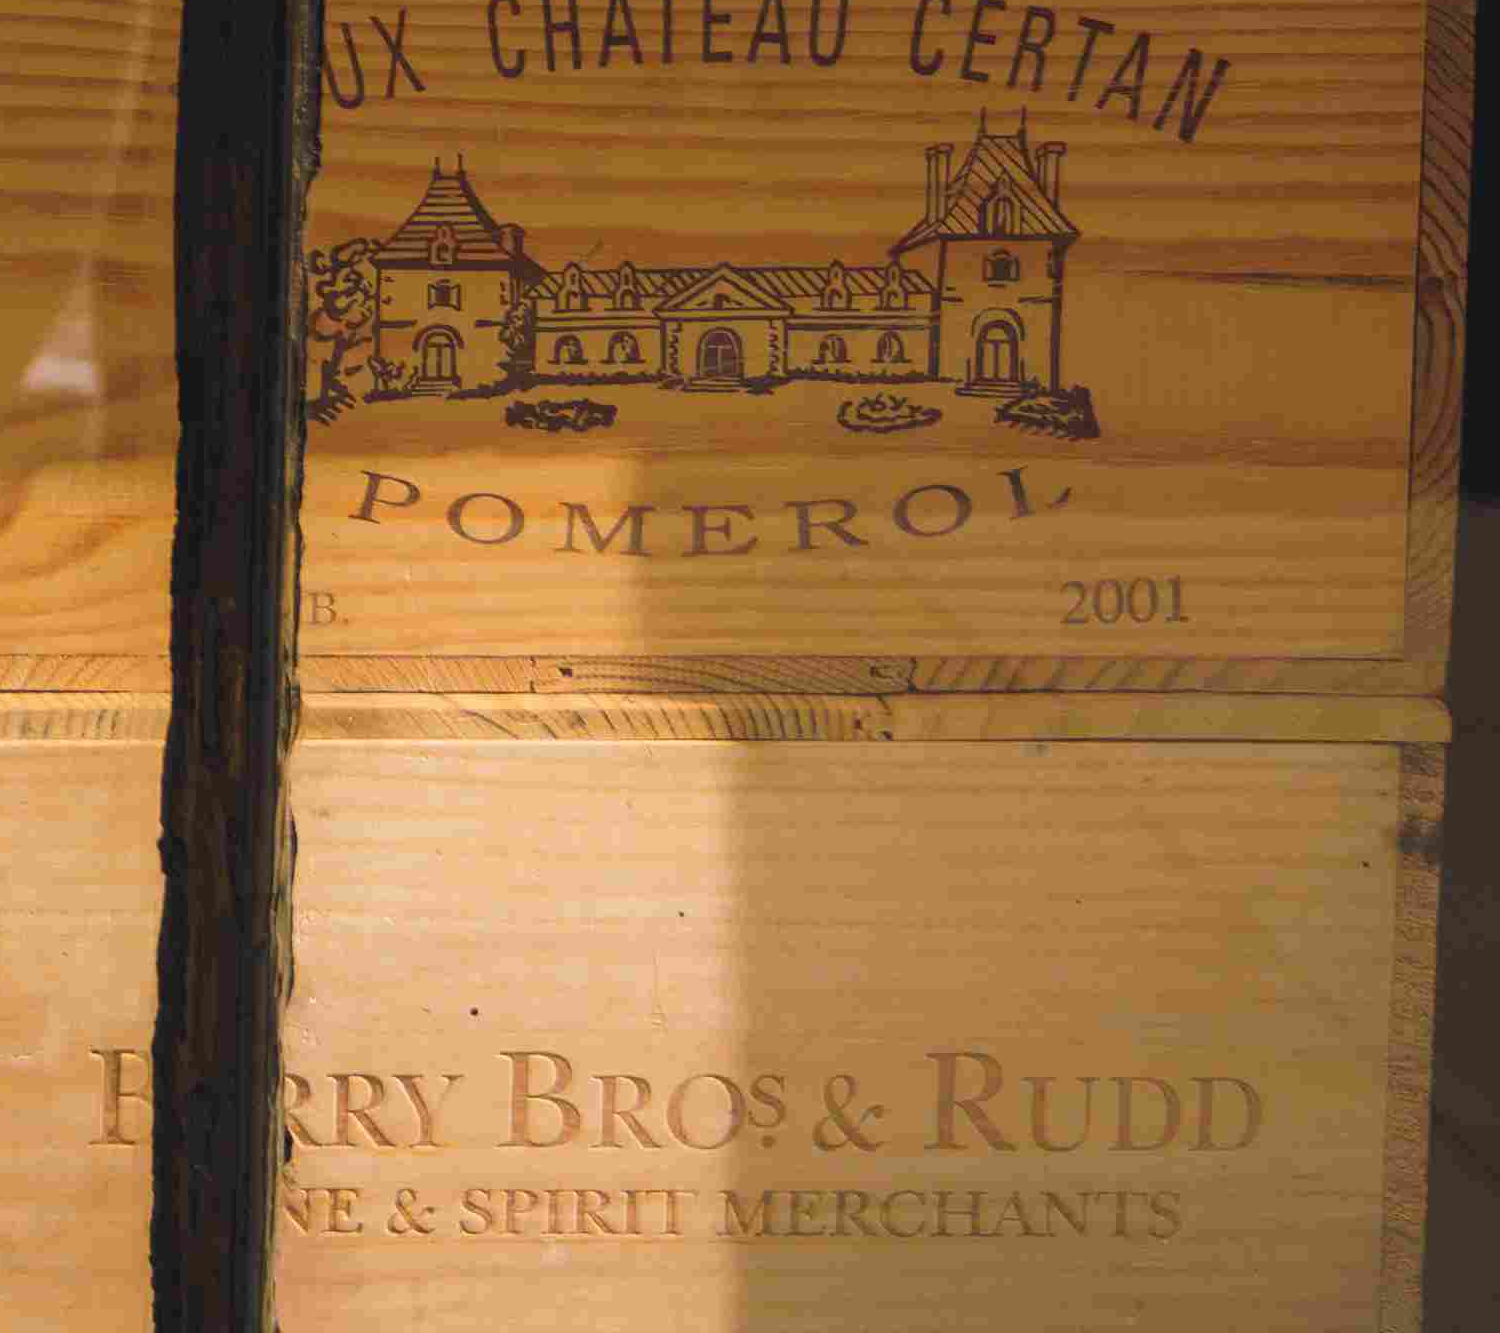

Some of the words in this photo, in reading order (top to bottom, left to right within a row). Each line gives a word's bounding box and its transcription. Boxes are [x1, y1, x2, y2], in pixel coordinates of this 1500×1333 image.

[346, 462, 1074, 559] POMEROL
[1059, 574, 1192, 628] 2001
[87, 1045, 460, 1152] BRRY
[812, 1076, 886, 1152] &
[924, 1049, 1266, 1155] RUDD
[281, 1187, 366, 1235] NE
[387, 1187, 437, 1237] &
[456, 1188, 697, 1238] SPIRIT
[714, 1187, 1184, 1239] MERCHANTS
